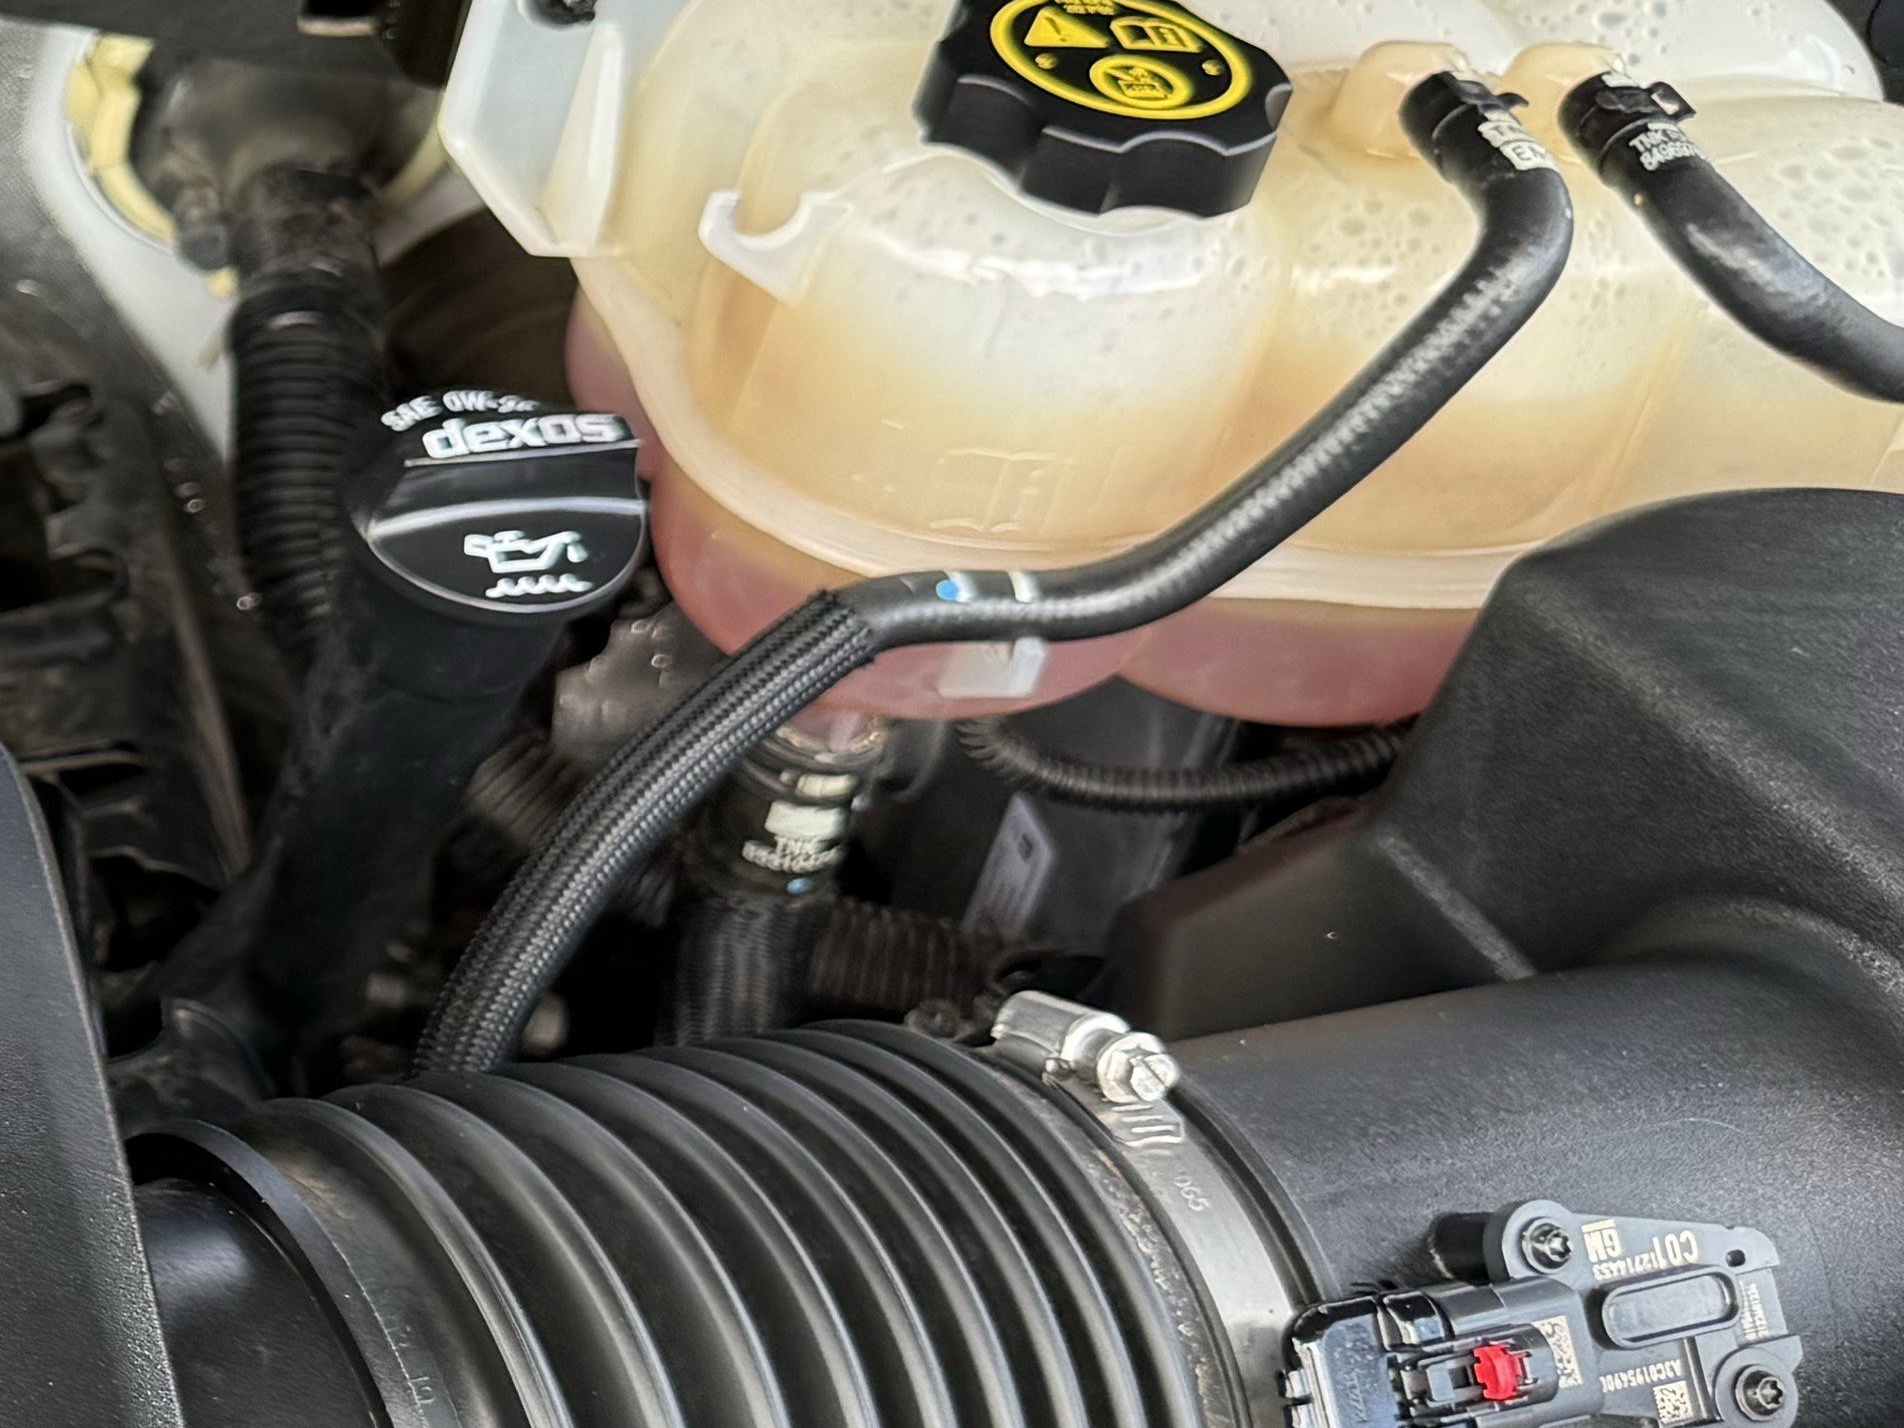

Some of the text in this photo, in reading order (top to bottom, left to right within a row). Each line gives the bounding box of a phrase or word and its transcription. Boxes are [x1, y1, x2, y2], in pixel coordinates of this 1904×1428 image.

[380, 395, 442, 432] SAE
[422, 412, 627, 459] dexos
[1583, 1227, 1622, 1262] GM
[1653, 1230, 1699, 1269] C01
